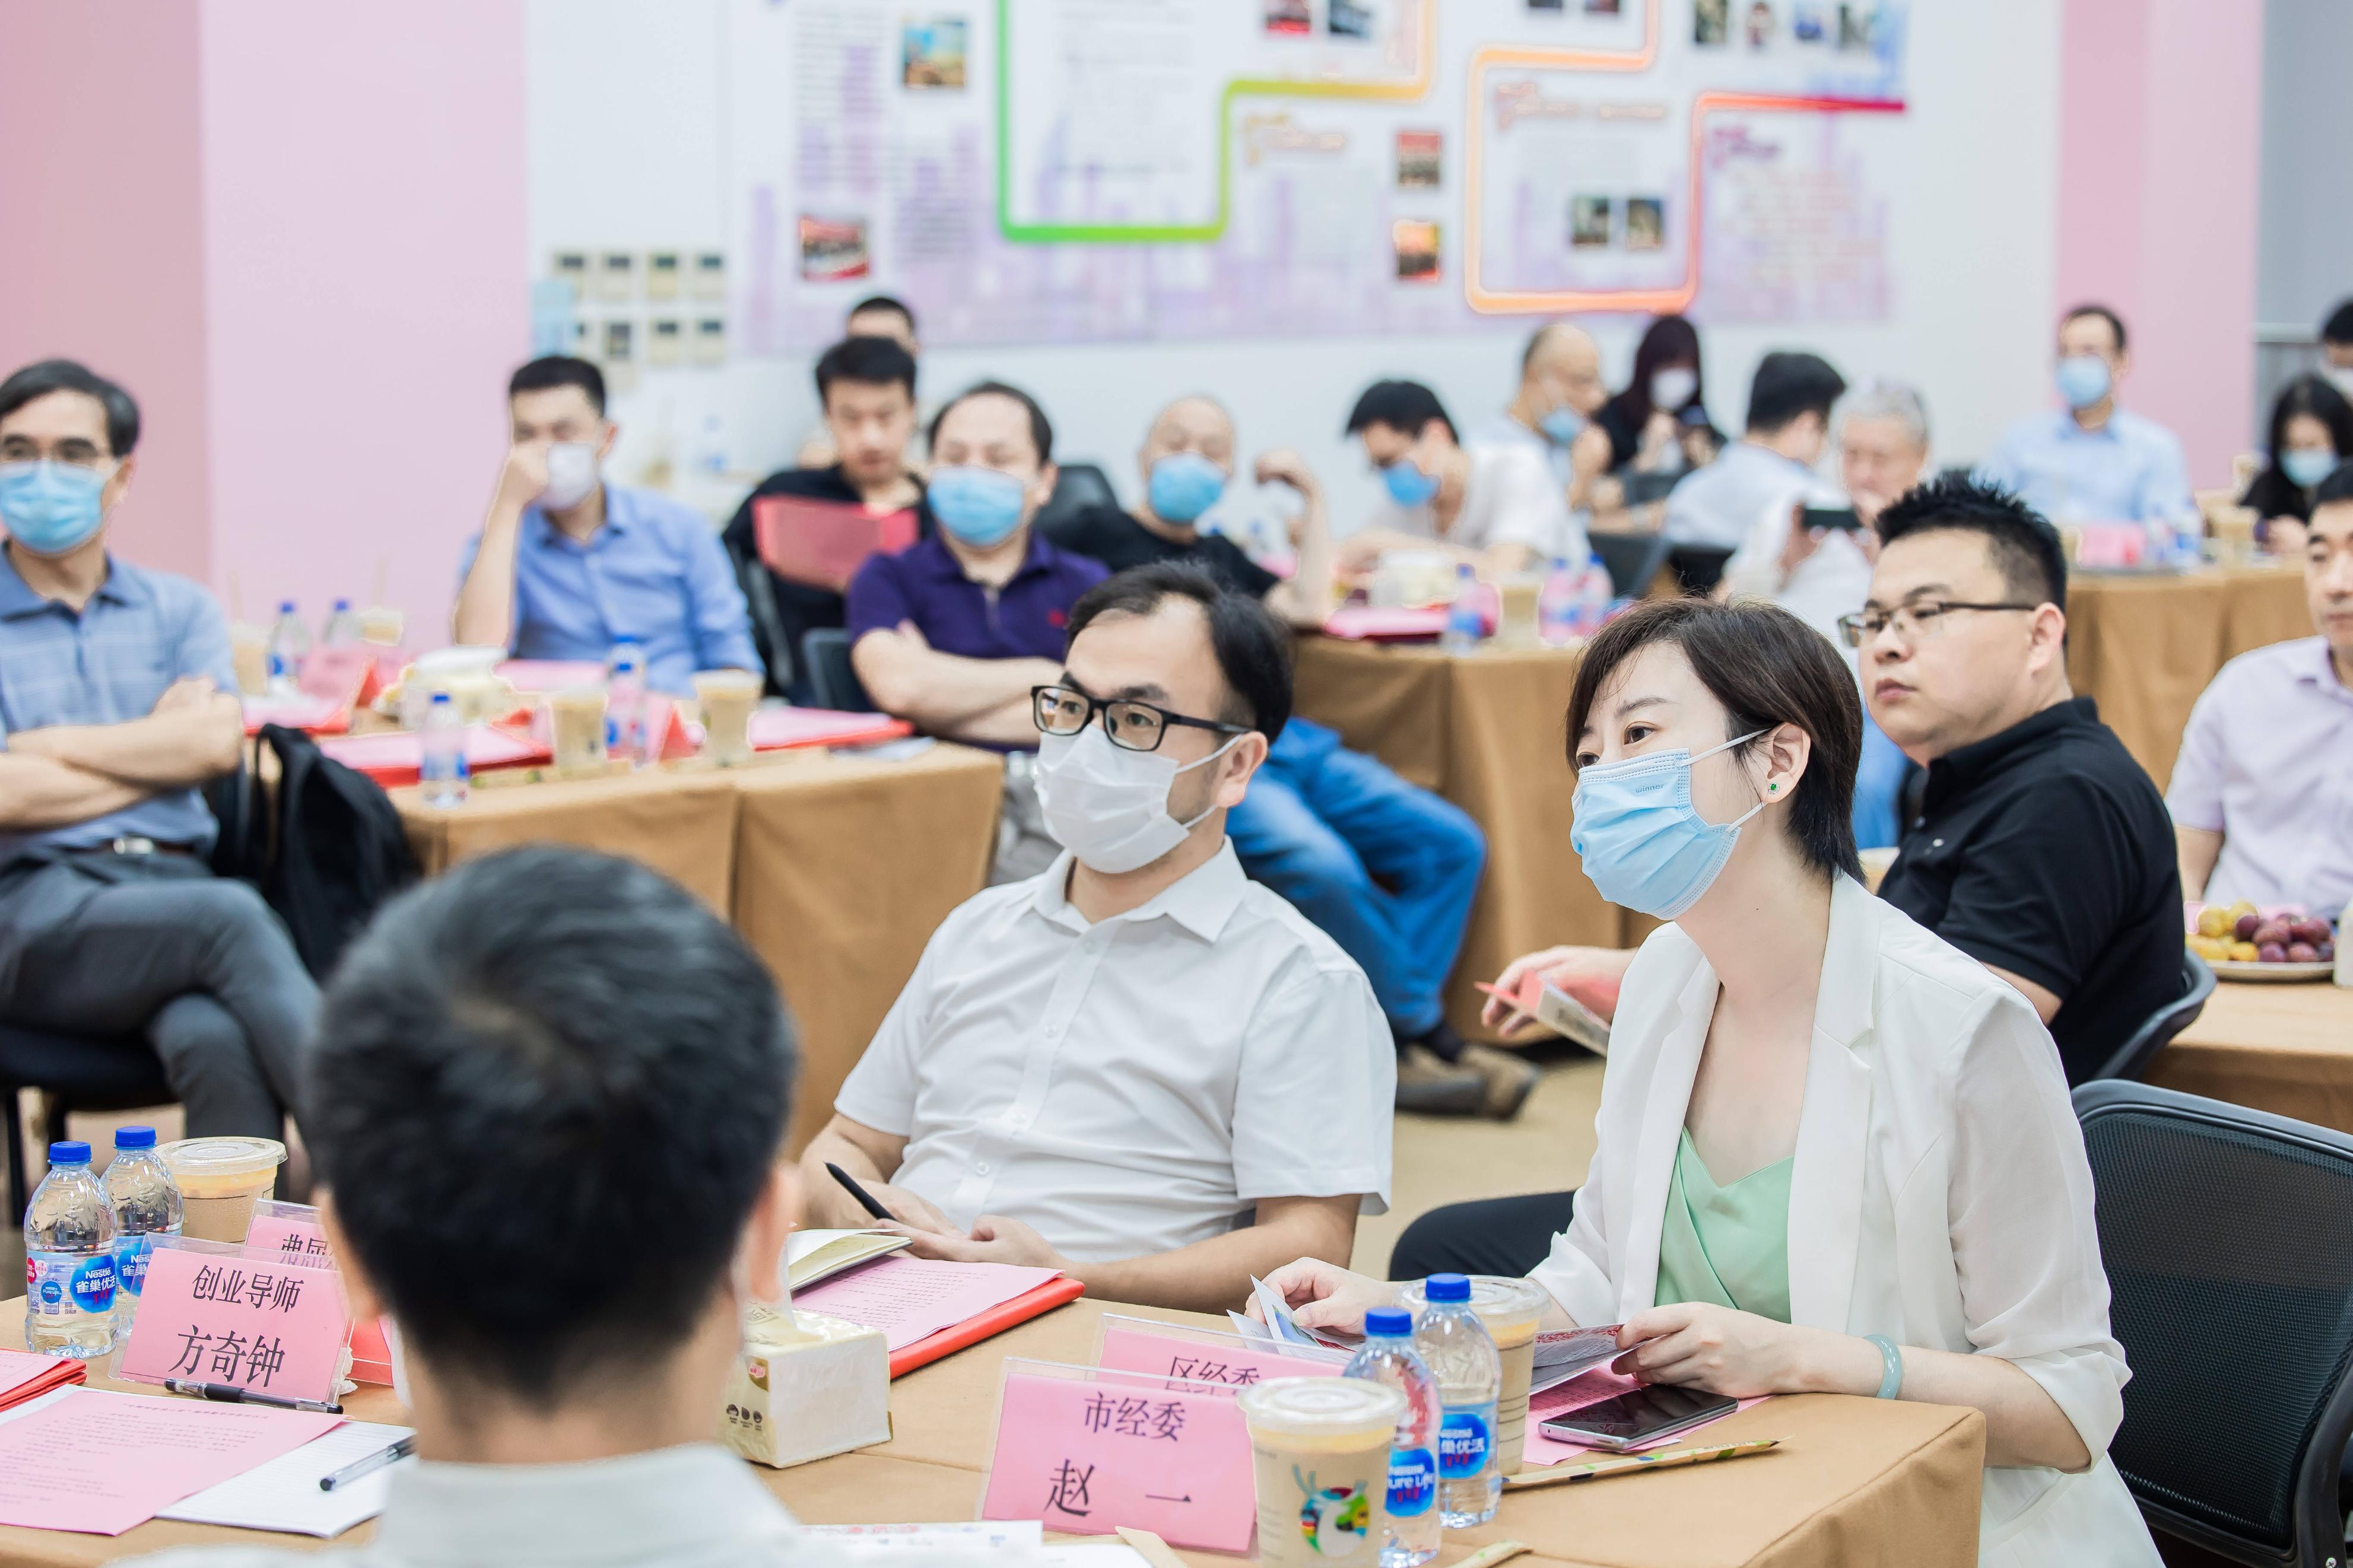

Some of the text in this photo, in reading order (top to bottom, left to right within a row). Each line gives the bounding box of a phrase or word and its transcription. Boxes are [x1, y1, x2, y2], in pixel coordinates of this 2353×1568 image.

[131, 1254, 152, 1263] Nes
[192, 1264, 304, 1313] 创业导师
[168, 1324, 285, 1387] 方奇钟
[1084, 1392, 1186, 1442] 市经委
